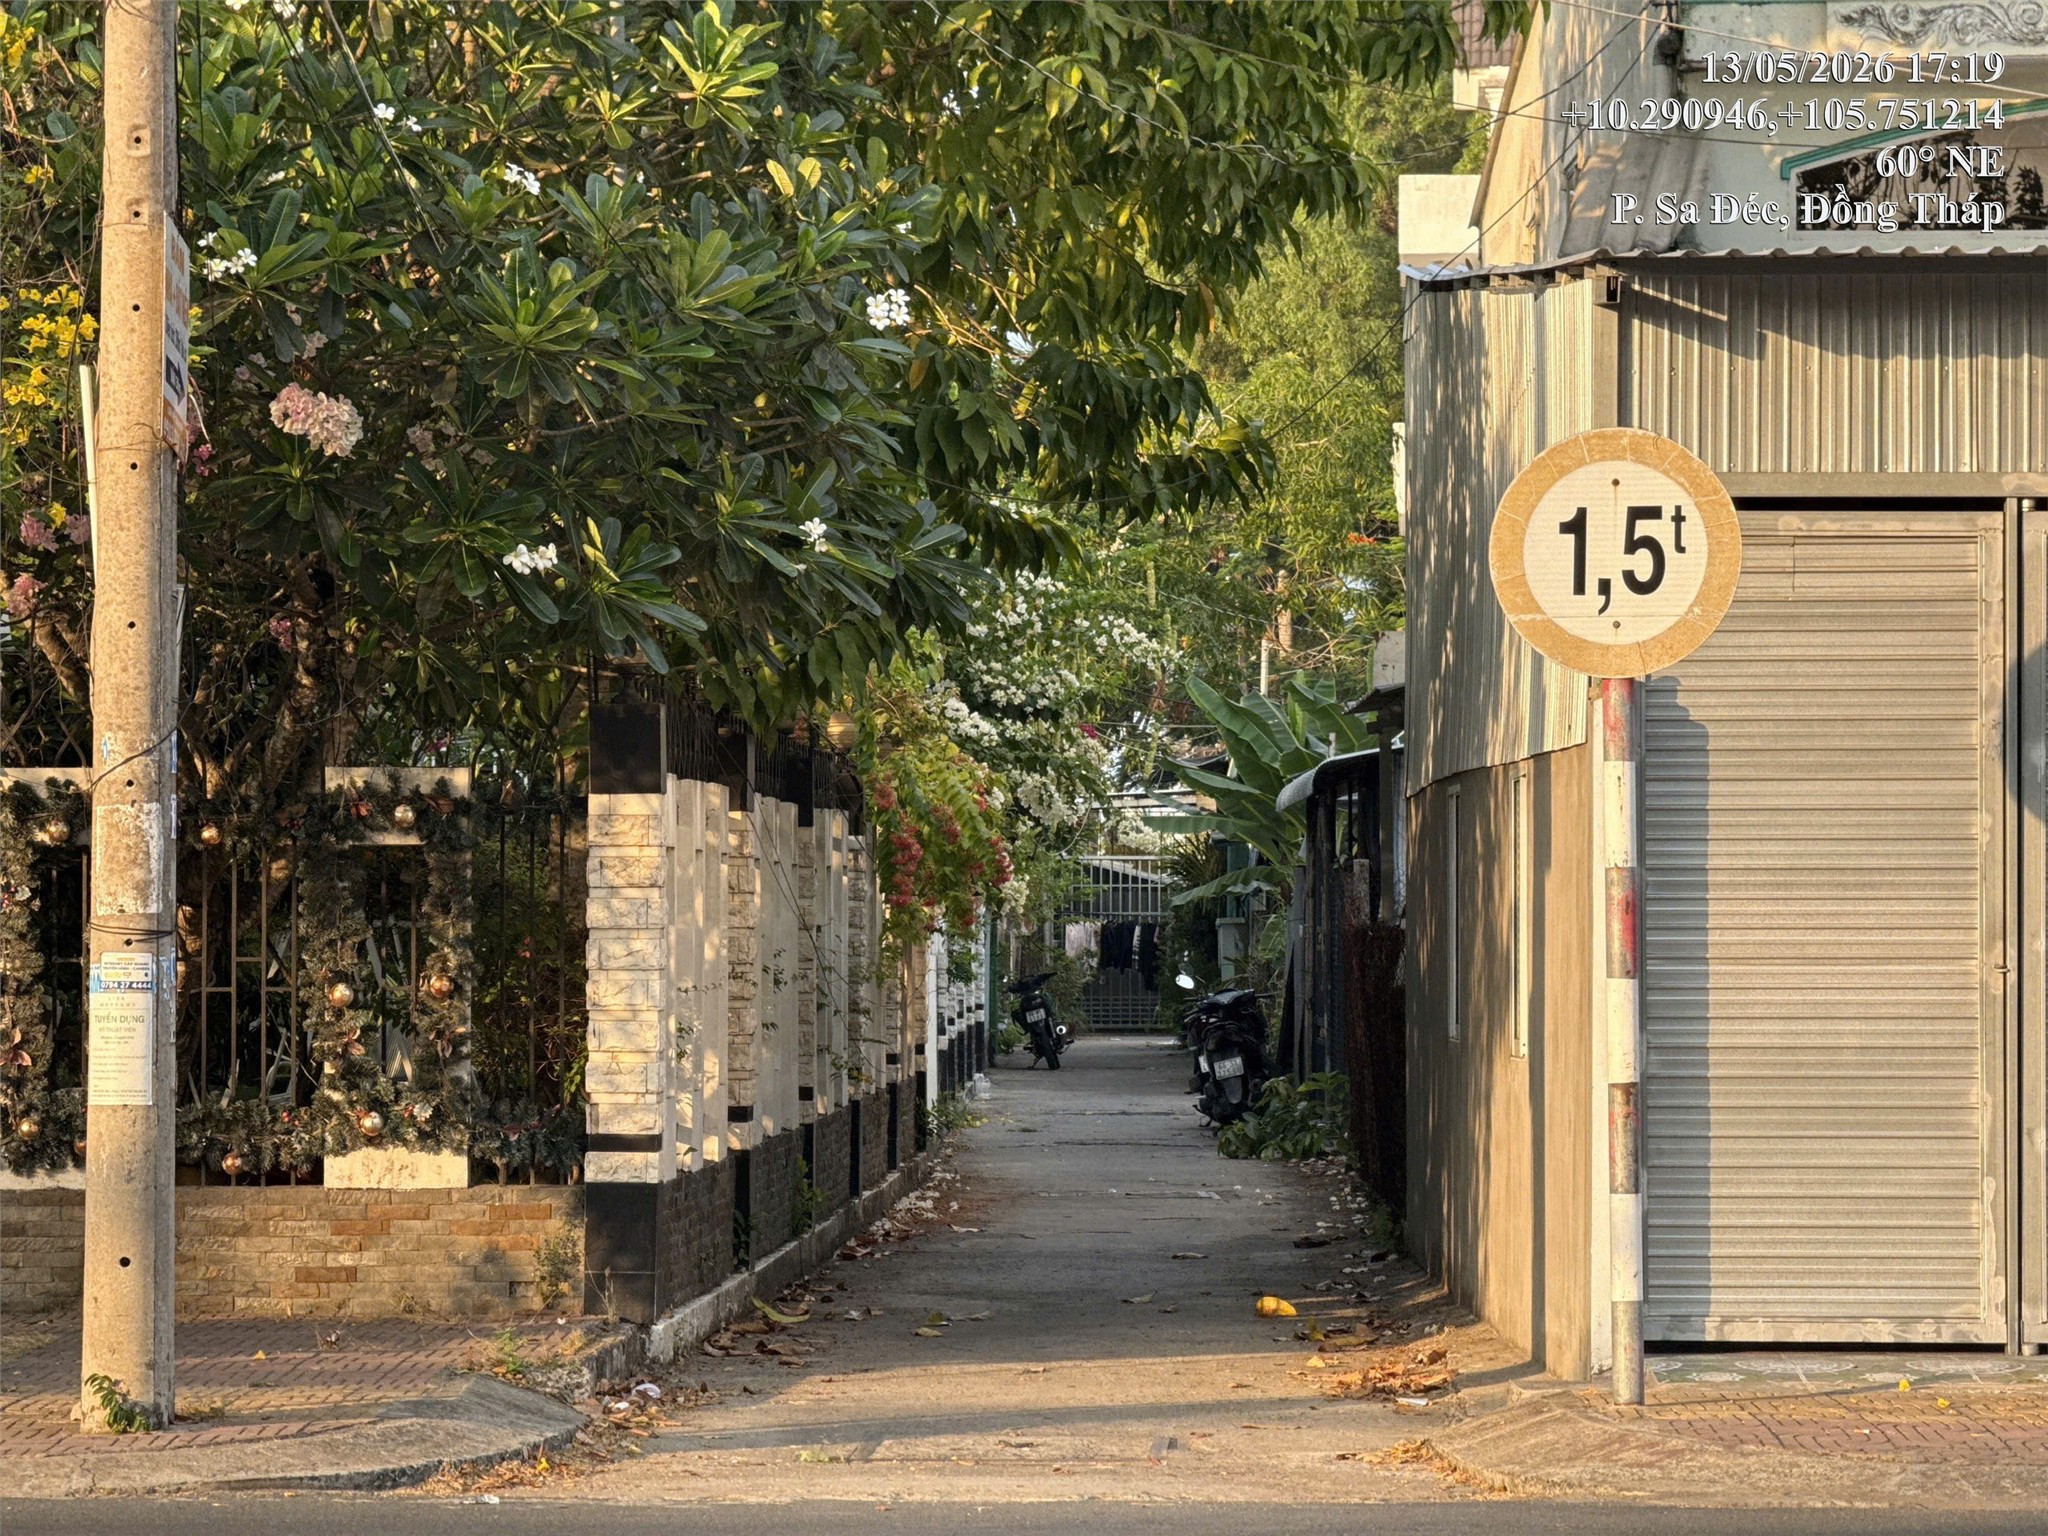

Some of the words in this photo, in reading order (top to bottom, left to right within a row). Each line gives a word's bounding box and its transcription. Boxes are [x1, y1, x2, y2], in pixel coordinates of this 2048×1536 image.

[120, 981, 130, 989] 27
[131, 981, 152, 989] 4444
[94, 1011, 117, 1023] TUYỂN
[119, 1014, 145, 1025] DỤNG
